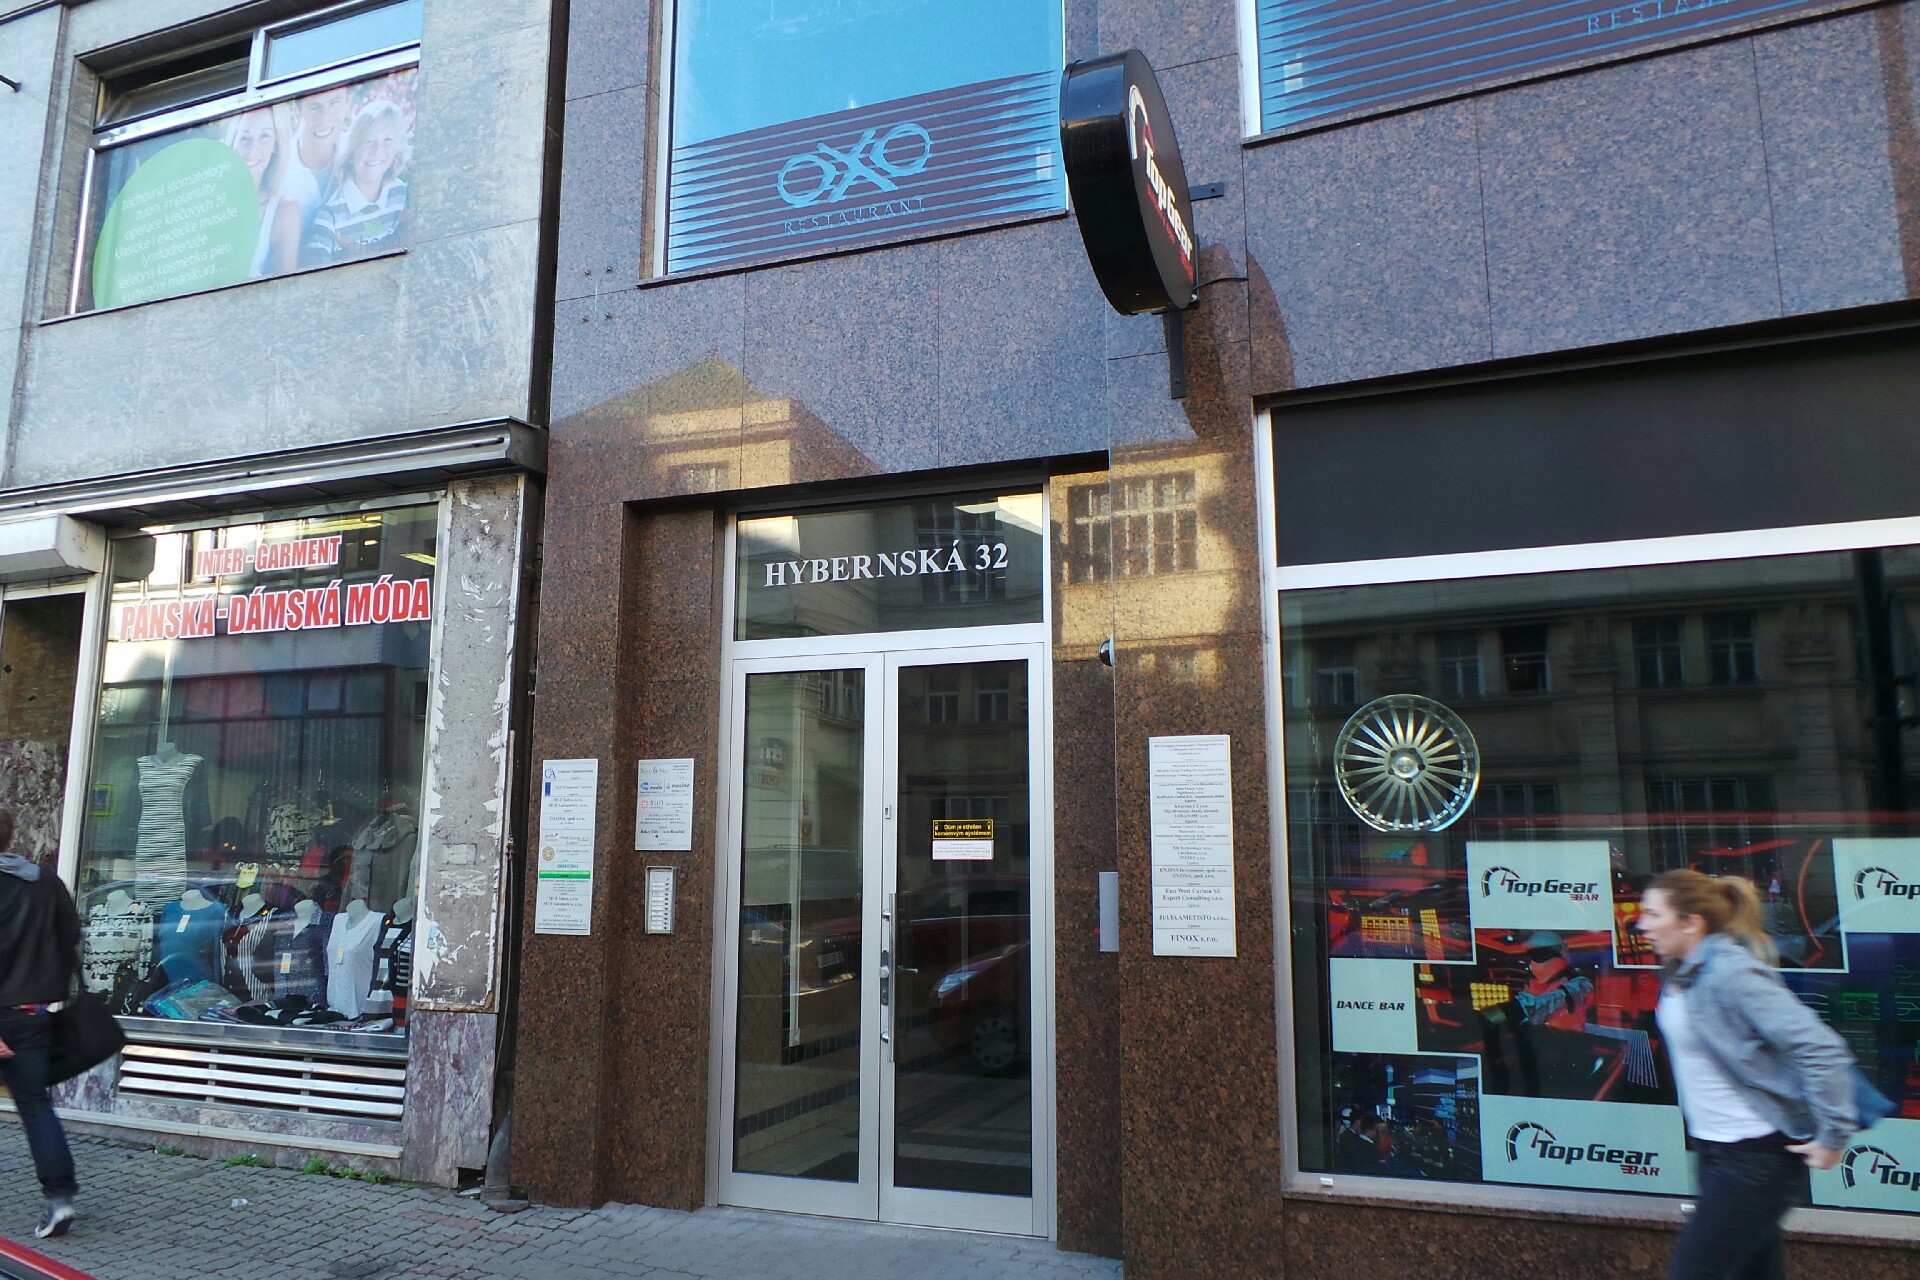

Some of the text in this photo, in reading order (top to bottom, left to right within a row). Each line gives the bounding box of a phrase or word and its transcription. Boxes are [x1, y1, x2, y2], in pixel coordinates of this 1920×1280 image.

[777, 122, 932, 209] OXO
[783, 198, 926, 236] RESTAURANT
[764, 539, 1010, 588] HYBERNSKÁ 32
[344, 574, 432, 627] MÓDA
[1170, 934, 1199, 942] FINOX
[1336, 1000, 1406, 1011] DANCE BAR
